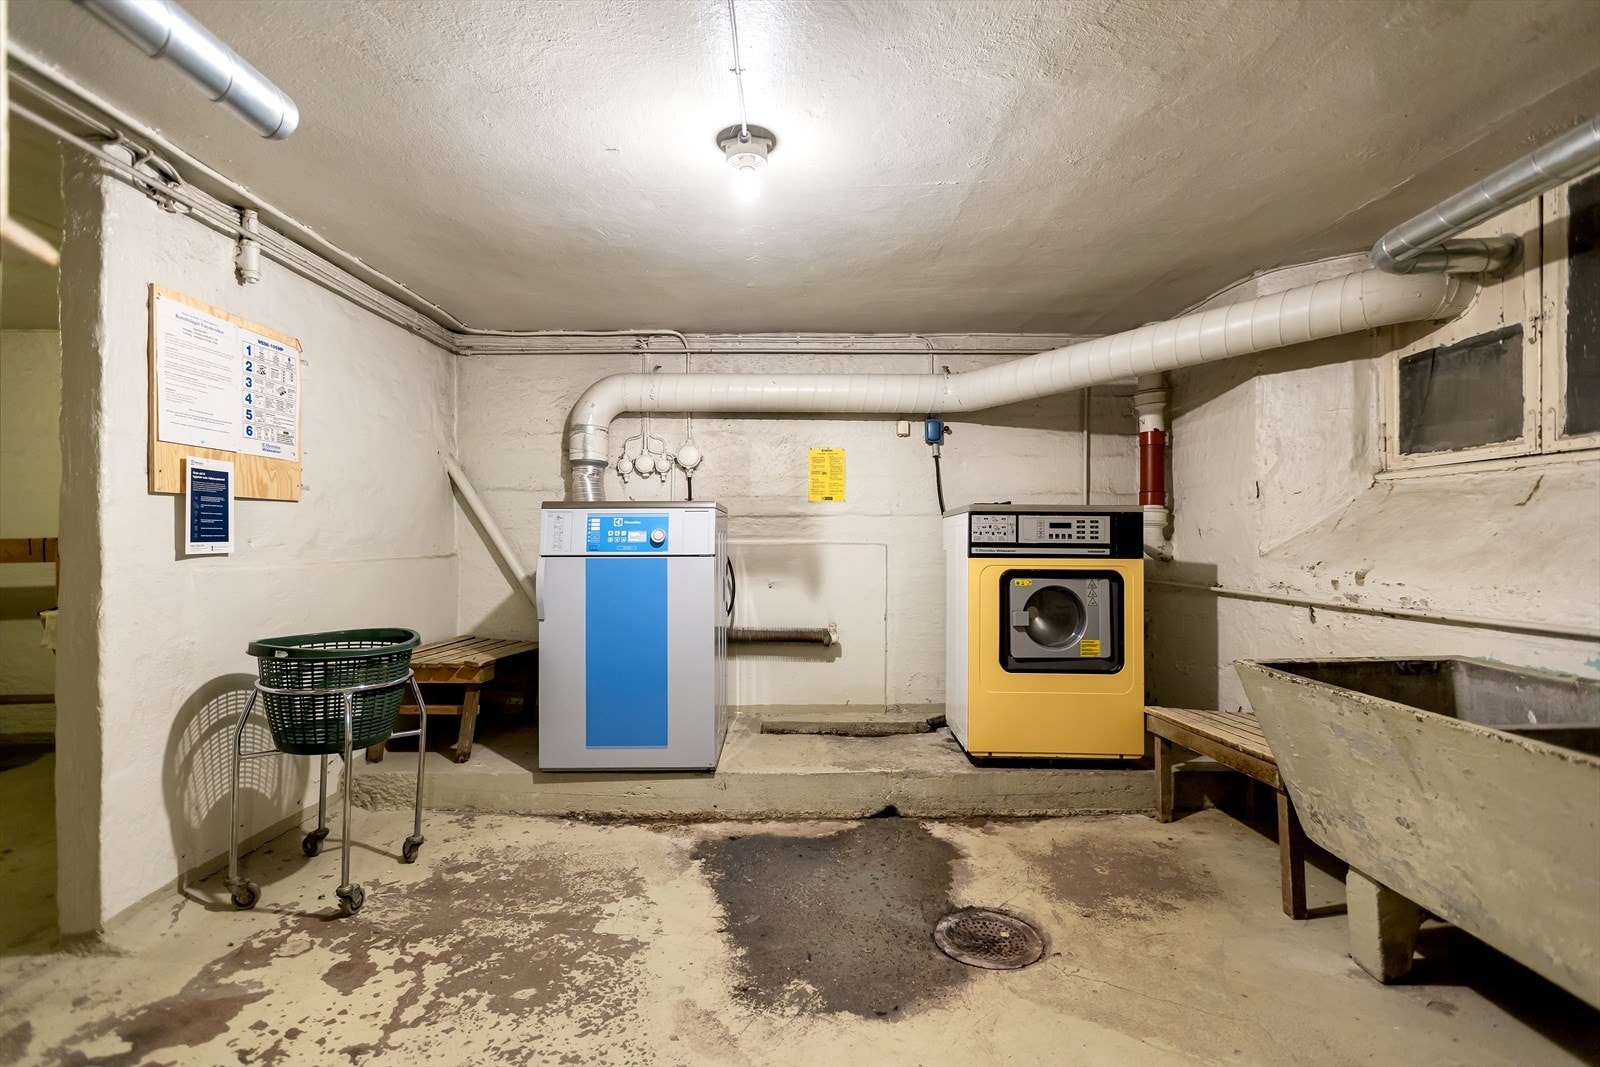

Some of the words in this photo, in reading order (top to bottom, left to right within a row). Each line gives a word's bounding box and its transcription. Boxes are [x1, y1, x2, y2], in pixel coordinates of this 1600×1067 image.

[246, 345, 252, 356] 1
[245, 360, 253, 372] 2
[245, 377, 253, 388] 3
[245, 393, 253, 404] 4
[245, 409, 253, 420] 5
[245, 425, 253, 436] 6
